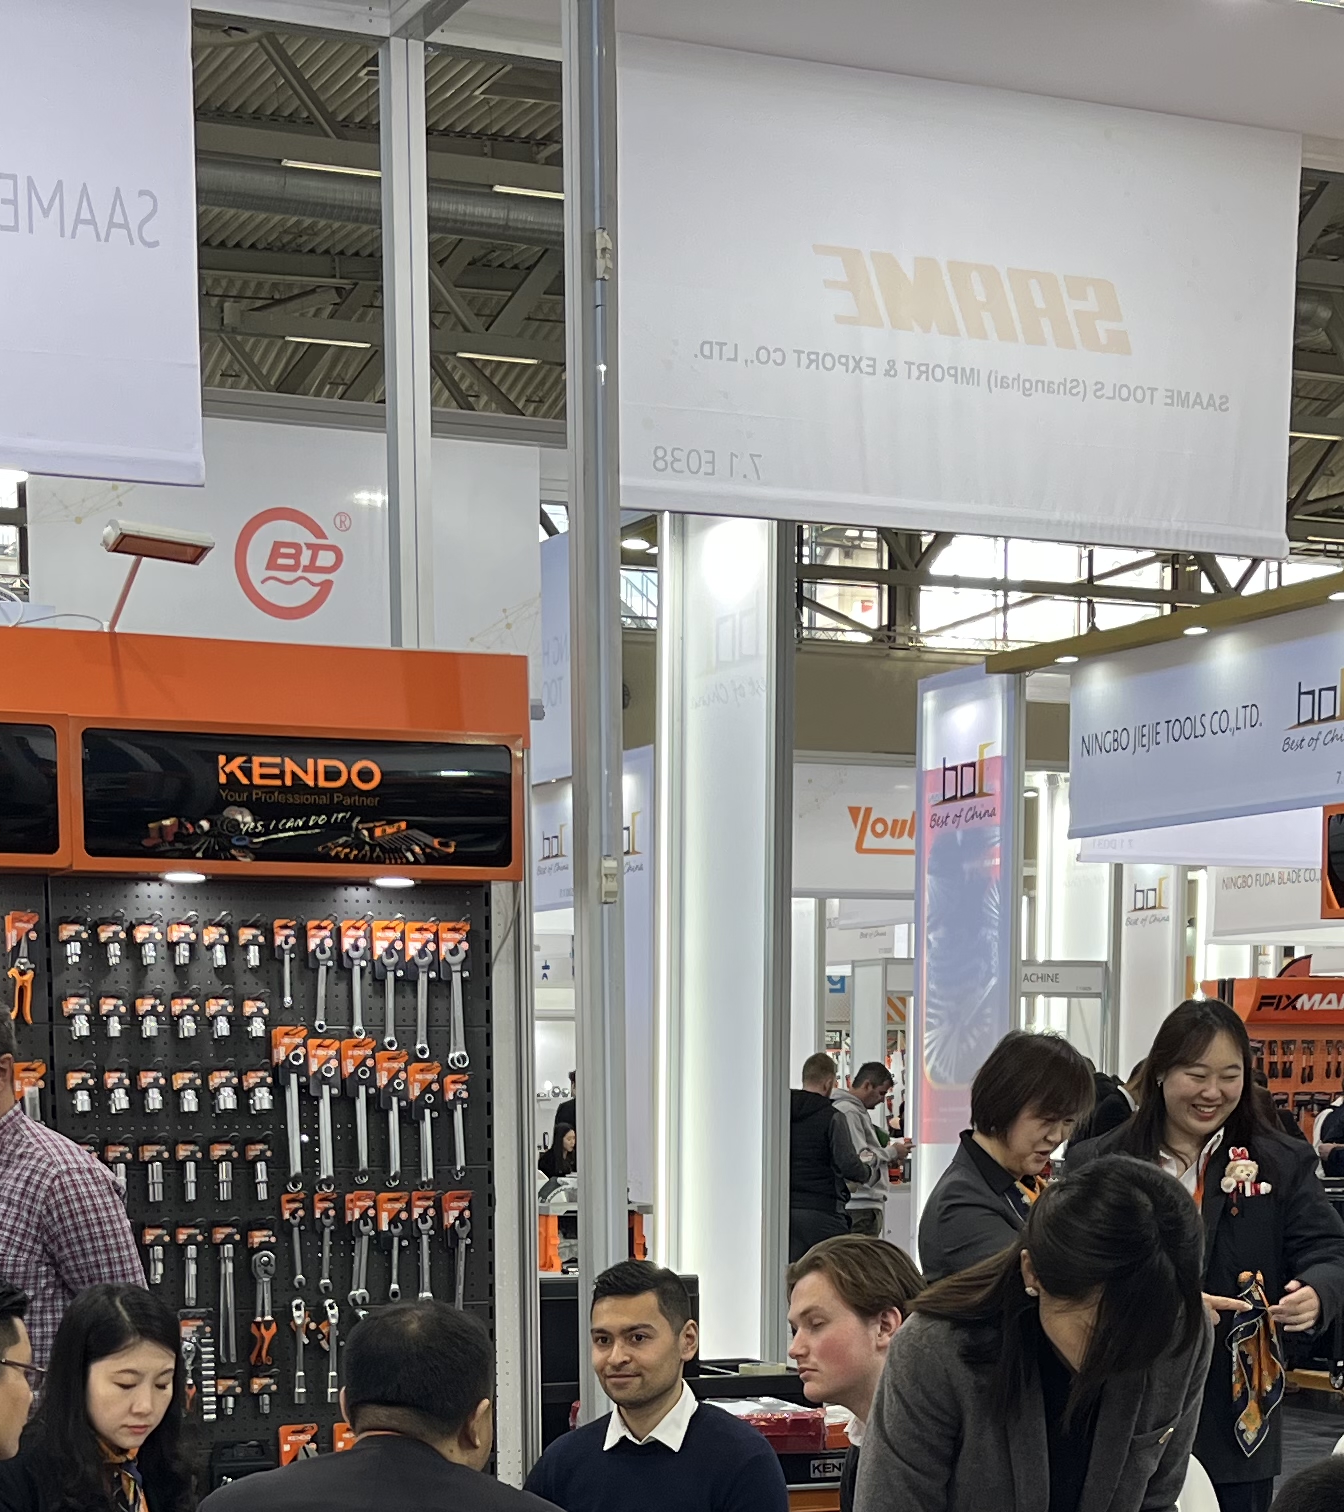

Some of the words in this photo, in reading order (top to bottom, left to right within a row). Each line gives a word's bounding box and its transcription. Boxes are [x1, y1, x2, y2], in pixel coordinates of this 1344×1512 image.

[1081, 728, 1130, 758] NINGBO
[1132, 722, 1162, 755] JIEJIE
[1164, 714, 1207, 744] TOOLS
[1209, 703, 1263, 738] CO.,LTD.
[1282, 733, 1304, 753] Best
[1306, 732, 1320, 752] of
[216, 754, 382, 791] KENDO
[219, 788, 249, 803] Your
[252, 789, 331, 806] Professional
[332, 792, 380, 807] Partner
[277, 817, 306, 831] CAN
[308, 815, 329, 827] DO
[929, 811, 951, 830] Best
[952, 810, 964, 829] of
[964, 805, 997, 822] China
[1222, 874, 1254, 890] NINGBO
[1255, 872, 1276, 888] FUDA
[1277, 869, 1302, 886] BLADE
[1022, 973, 1060, 984] ACHINE
[812, 1462, 846, 1475] KEN
